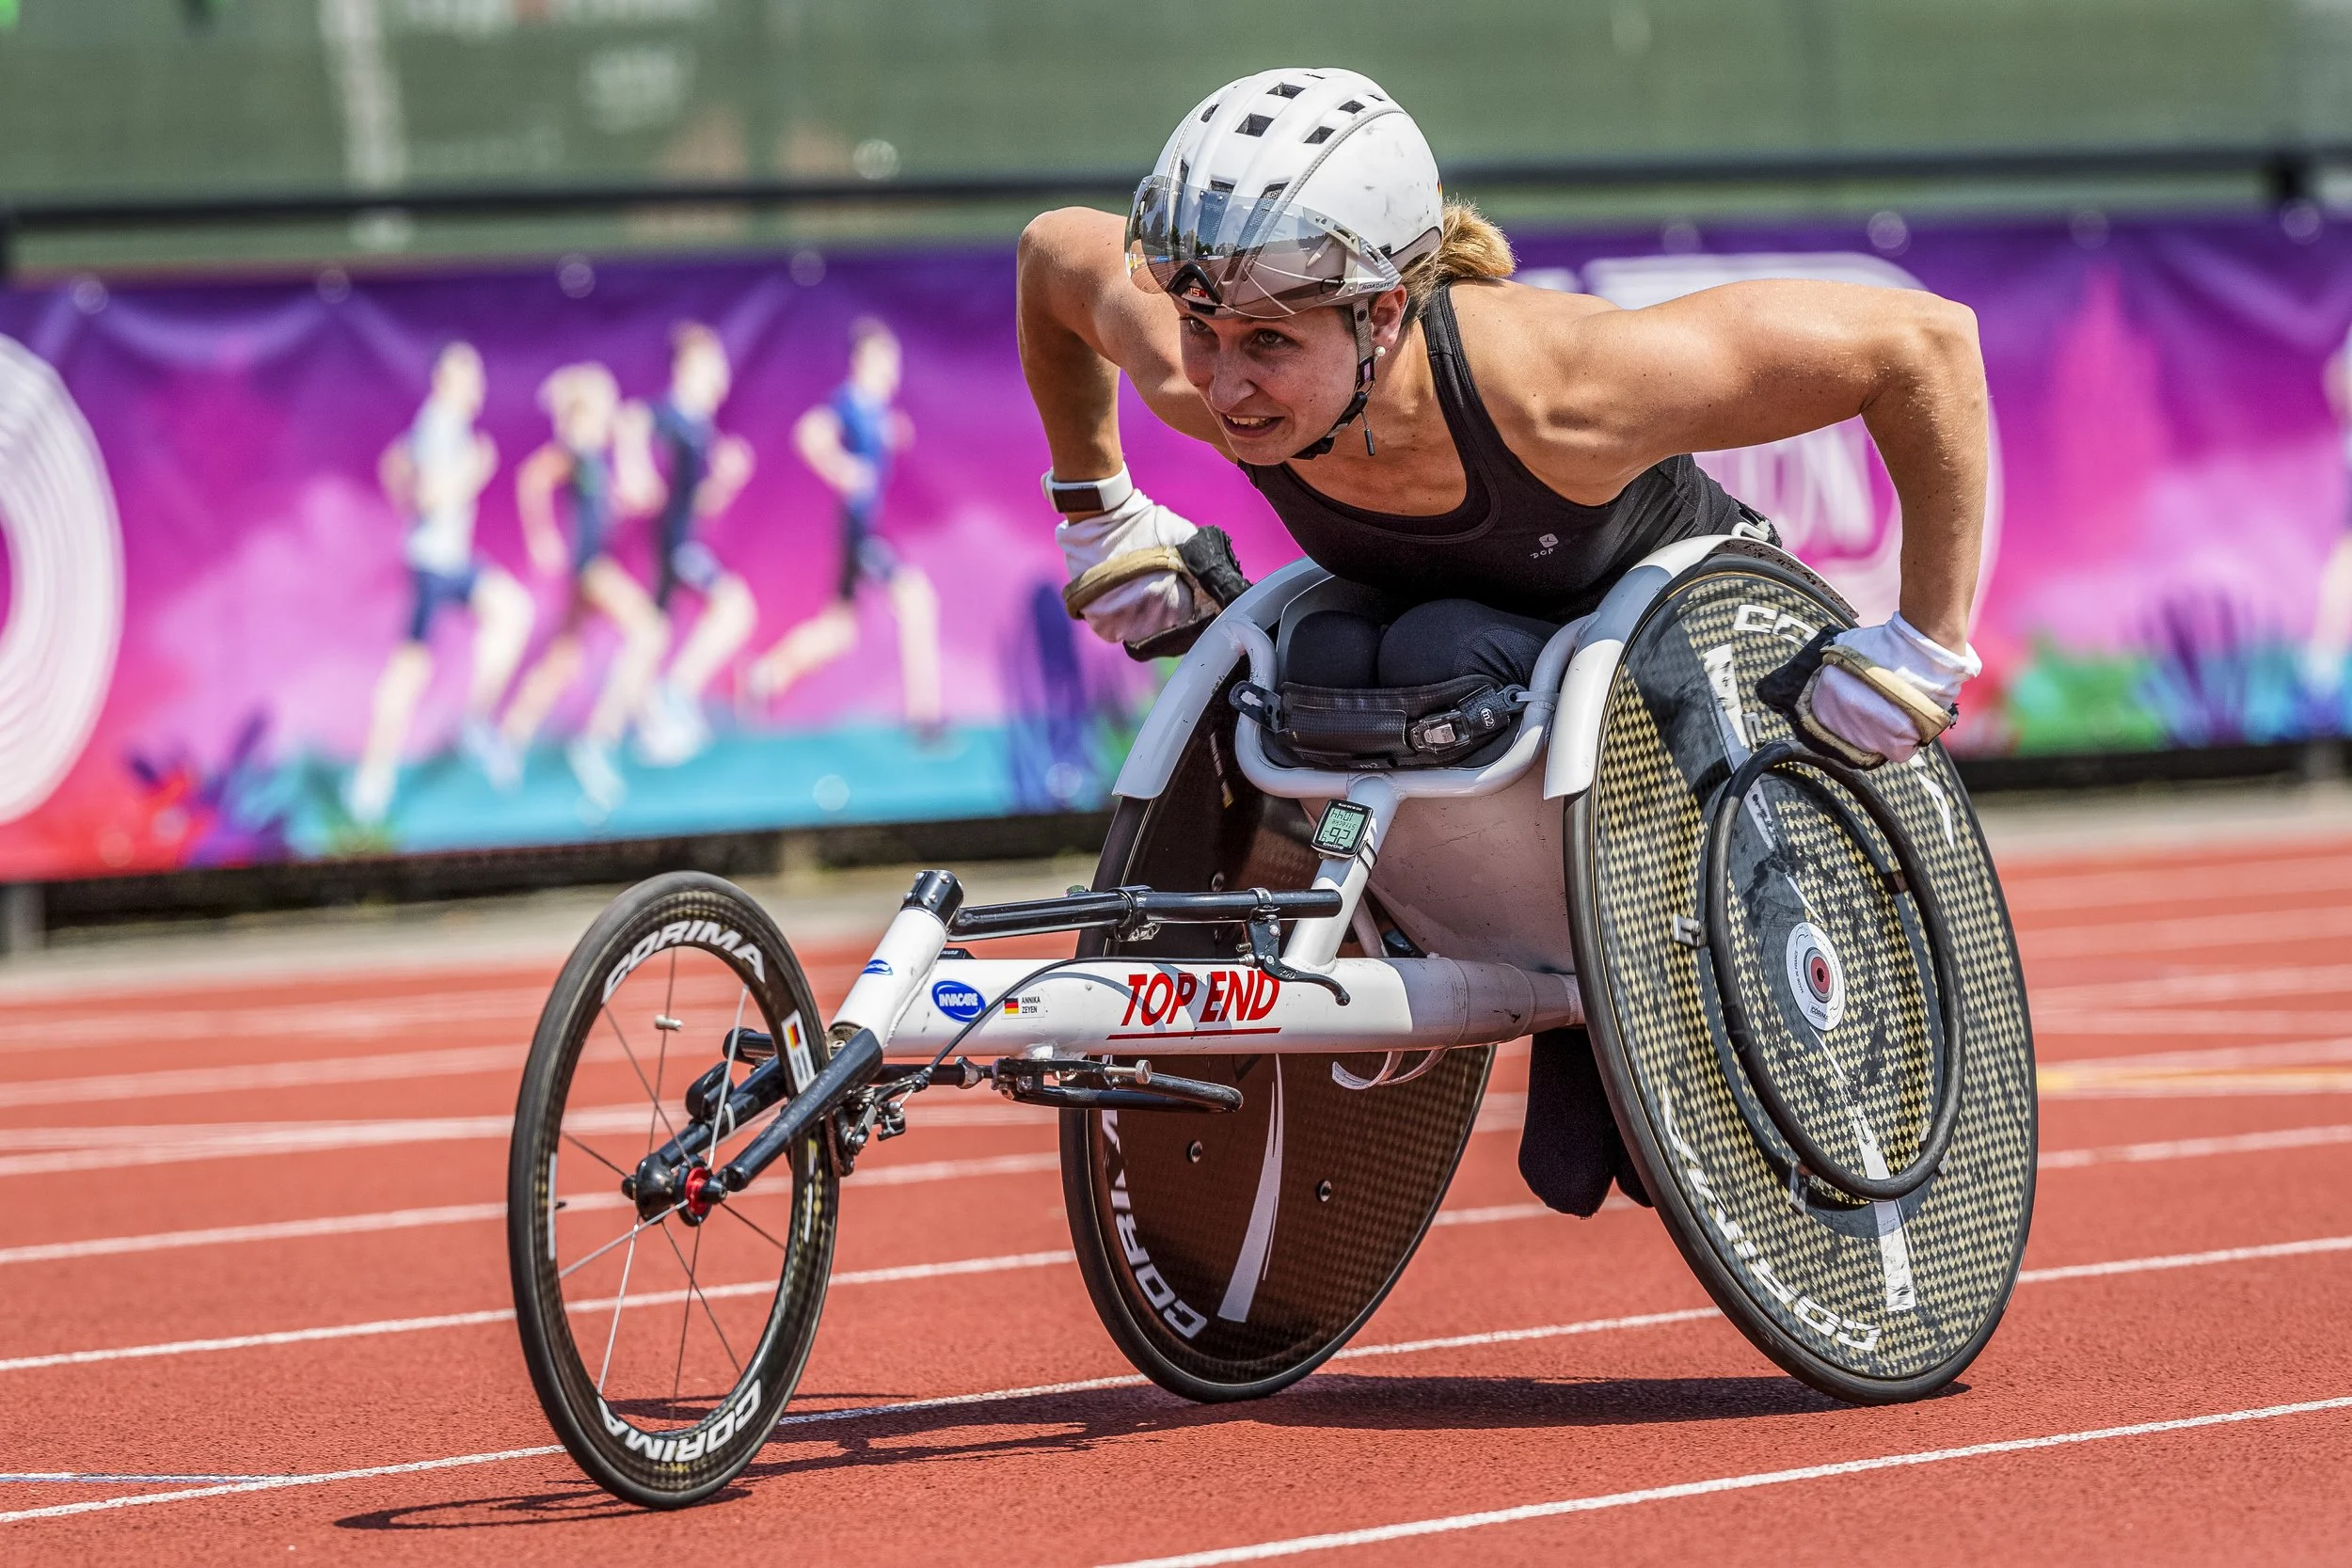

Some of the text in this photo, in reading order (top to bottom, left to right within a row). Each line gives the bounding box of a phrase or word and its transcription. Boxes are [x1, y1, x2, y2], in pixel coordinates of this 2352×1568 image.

[602, 920, 766, 1005] CORIMA
[939, 992, 978, 1007] INVACARE
[1021, 995, 1041, 1005] ANNIKA
[1021, 1006, 1038, 1014] ZEYEN
[1120, 970, 1280, 1027] TOP END
[597, 1379, 762, 1463] CORIMA
